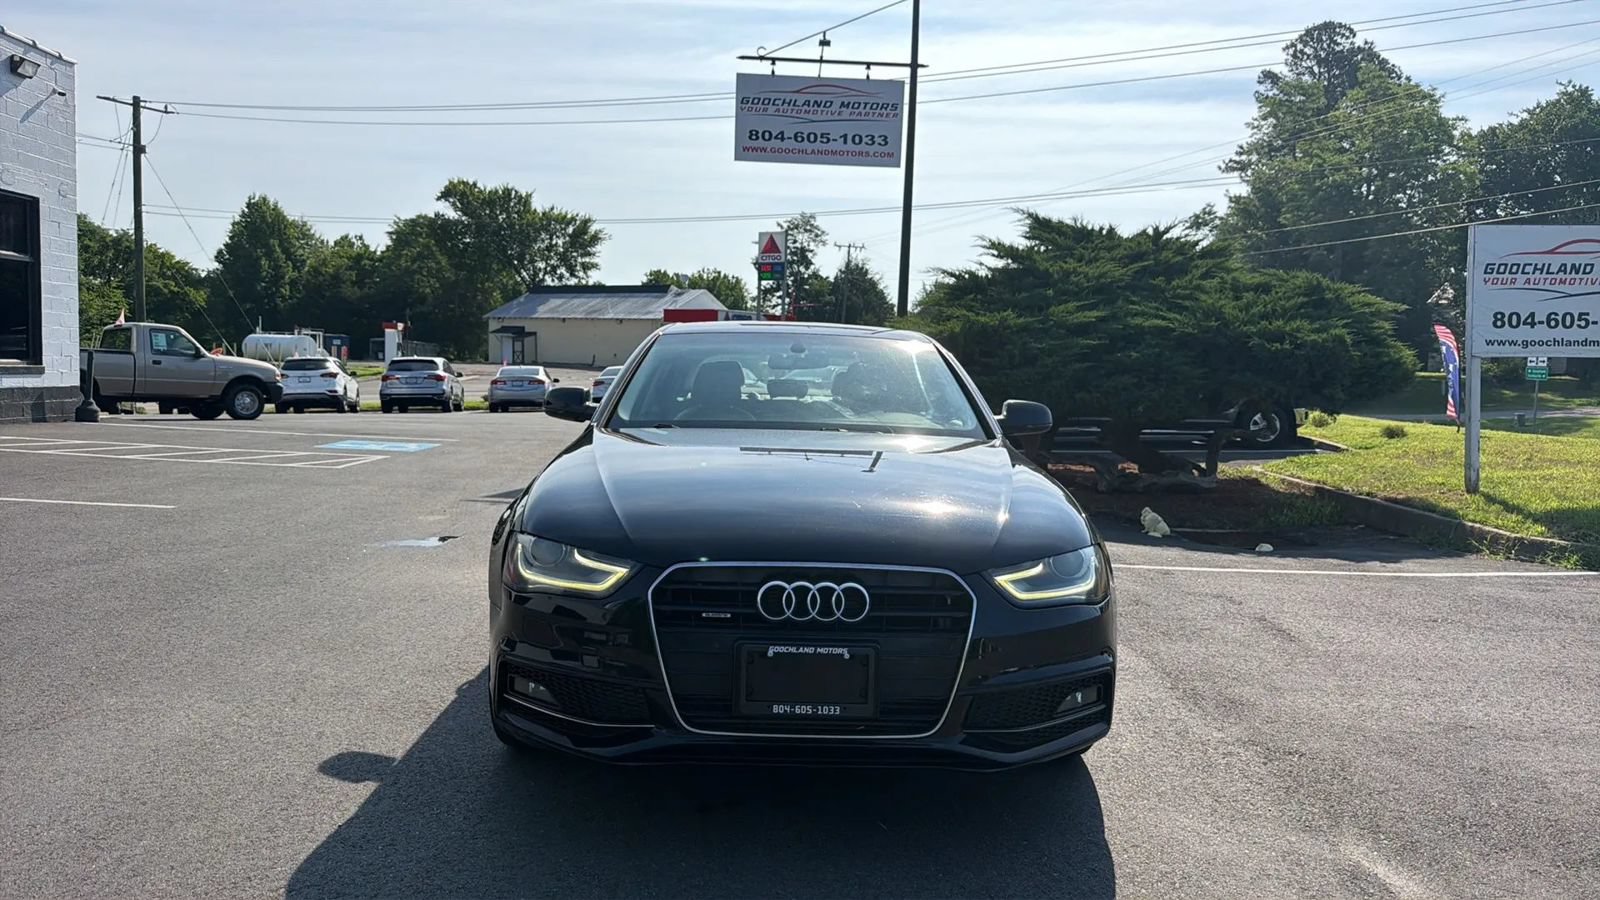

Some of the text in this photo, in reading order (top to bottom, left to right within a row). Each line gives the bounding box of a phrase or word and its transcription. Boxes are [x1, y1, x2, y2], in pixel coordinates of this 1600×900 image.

[740, 96, 899, 112] GOOCHLAND MOTORS
[774, 107, 844, 117] AUTOMOTIVE
[849, 110, 899, 119] PARTNER
[748, 129, 889, 147] 804-605-1033
[742, 146, 894, 159] WWW.GOOCHLANDMOTORS.COM
[1483, 263, 1595, 275] GOOCHLAND
[1483, 277, 1600, 286] YOUR AUTOMOTIV
[1492, 311, 1598, 329] 804-605-
[772, 704, 840, 715] 804-605-1033
